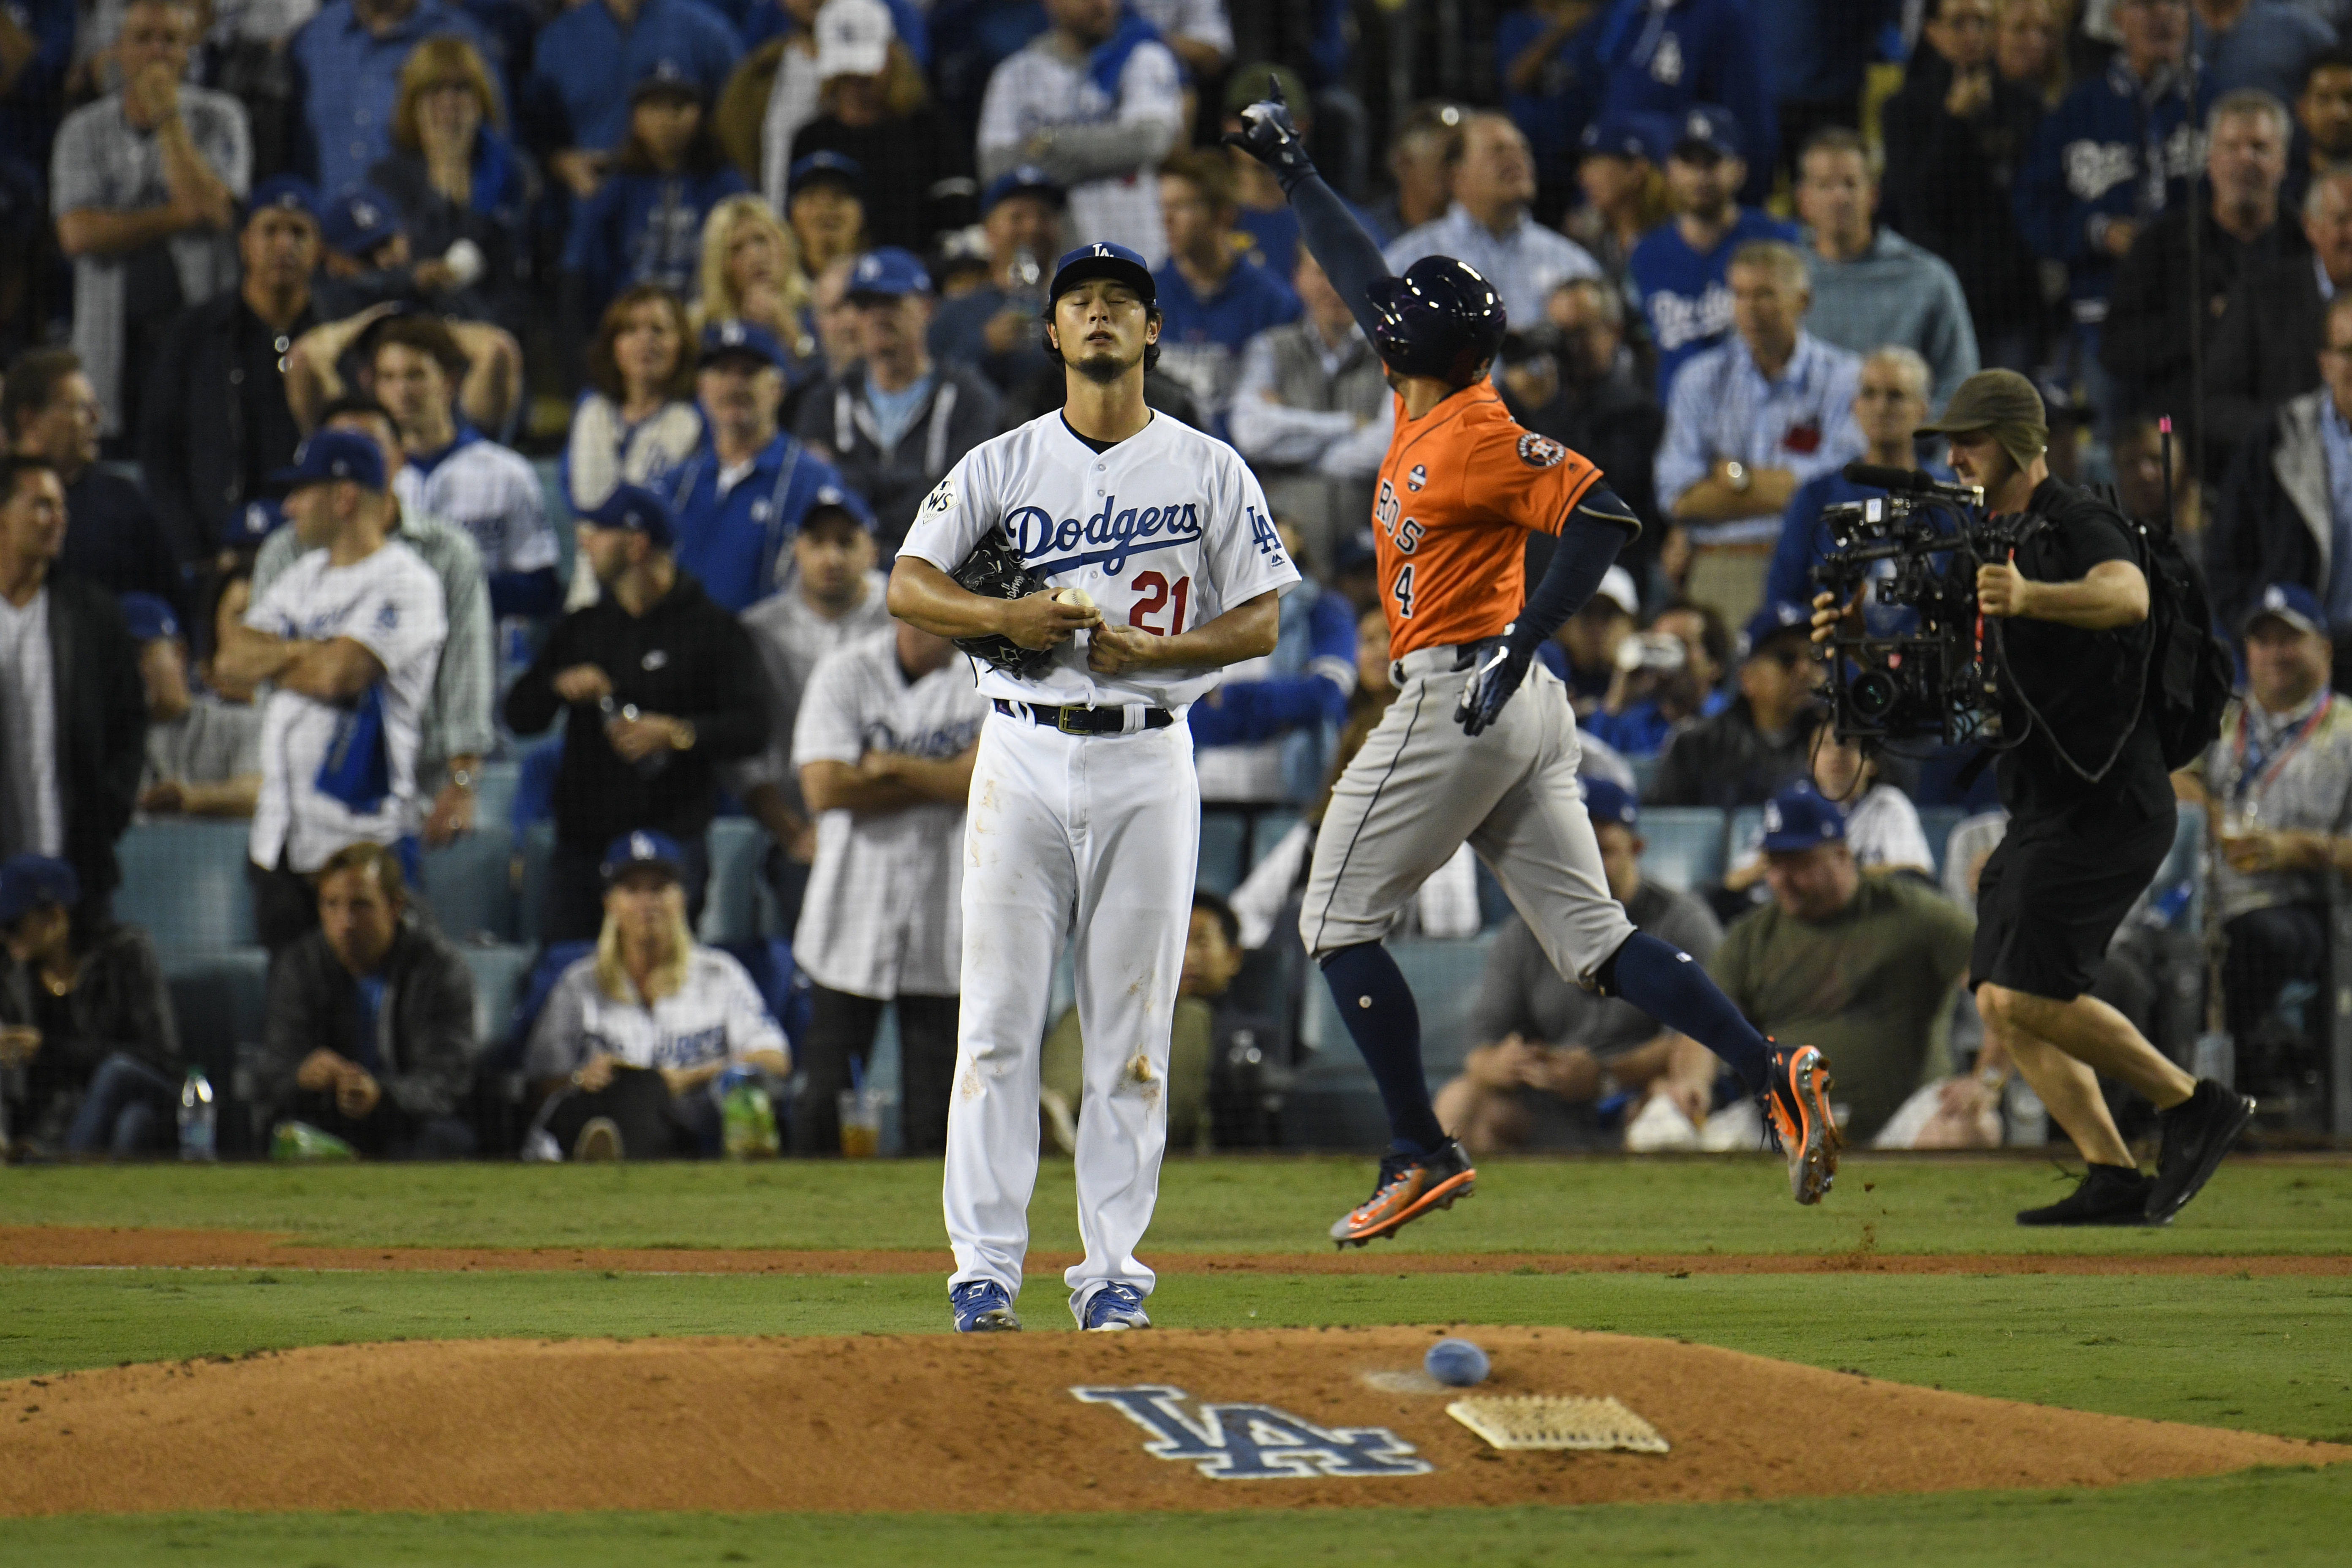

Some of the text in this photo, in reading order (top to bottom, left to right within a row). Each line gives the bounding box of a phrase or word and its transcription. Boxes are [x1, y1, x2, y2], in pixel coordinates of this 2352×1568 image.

[927, 493, 953, 512] WS
[1246, 506, 1282, 554] LA
[1005, 495, 1202, 577] Dodgers
[1129, 570, 1190, 637] 21
[1394, 562, 1415, 619] 4
[1069, 1384, 1433, 1479] LA
